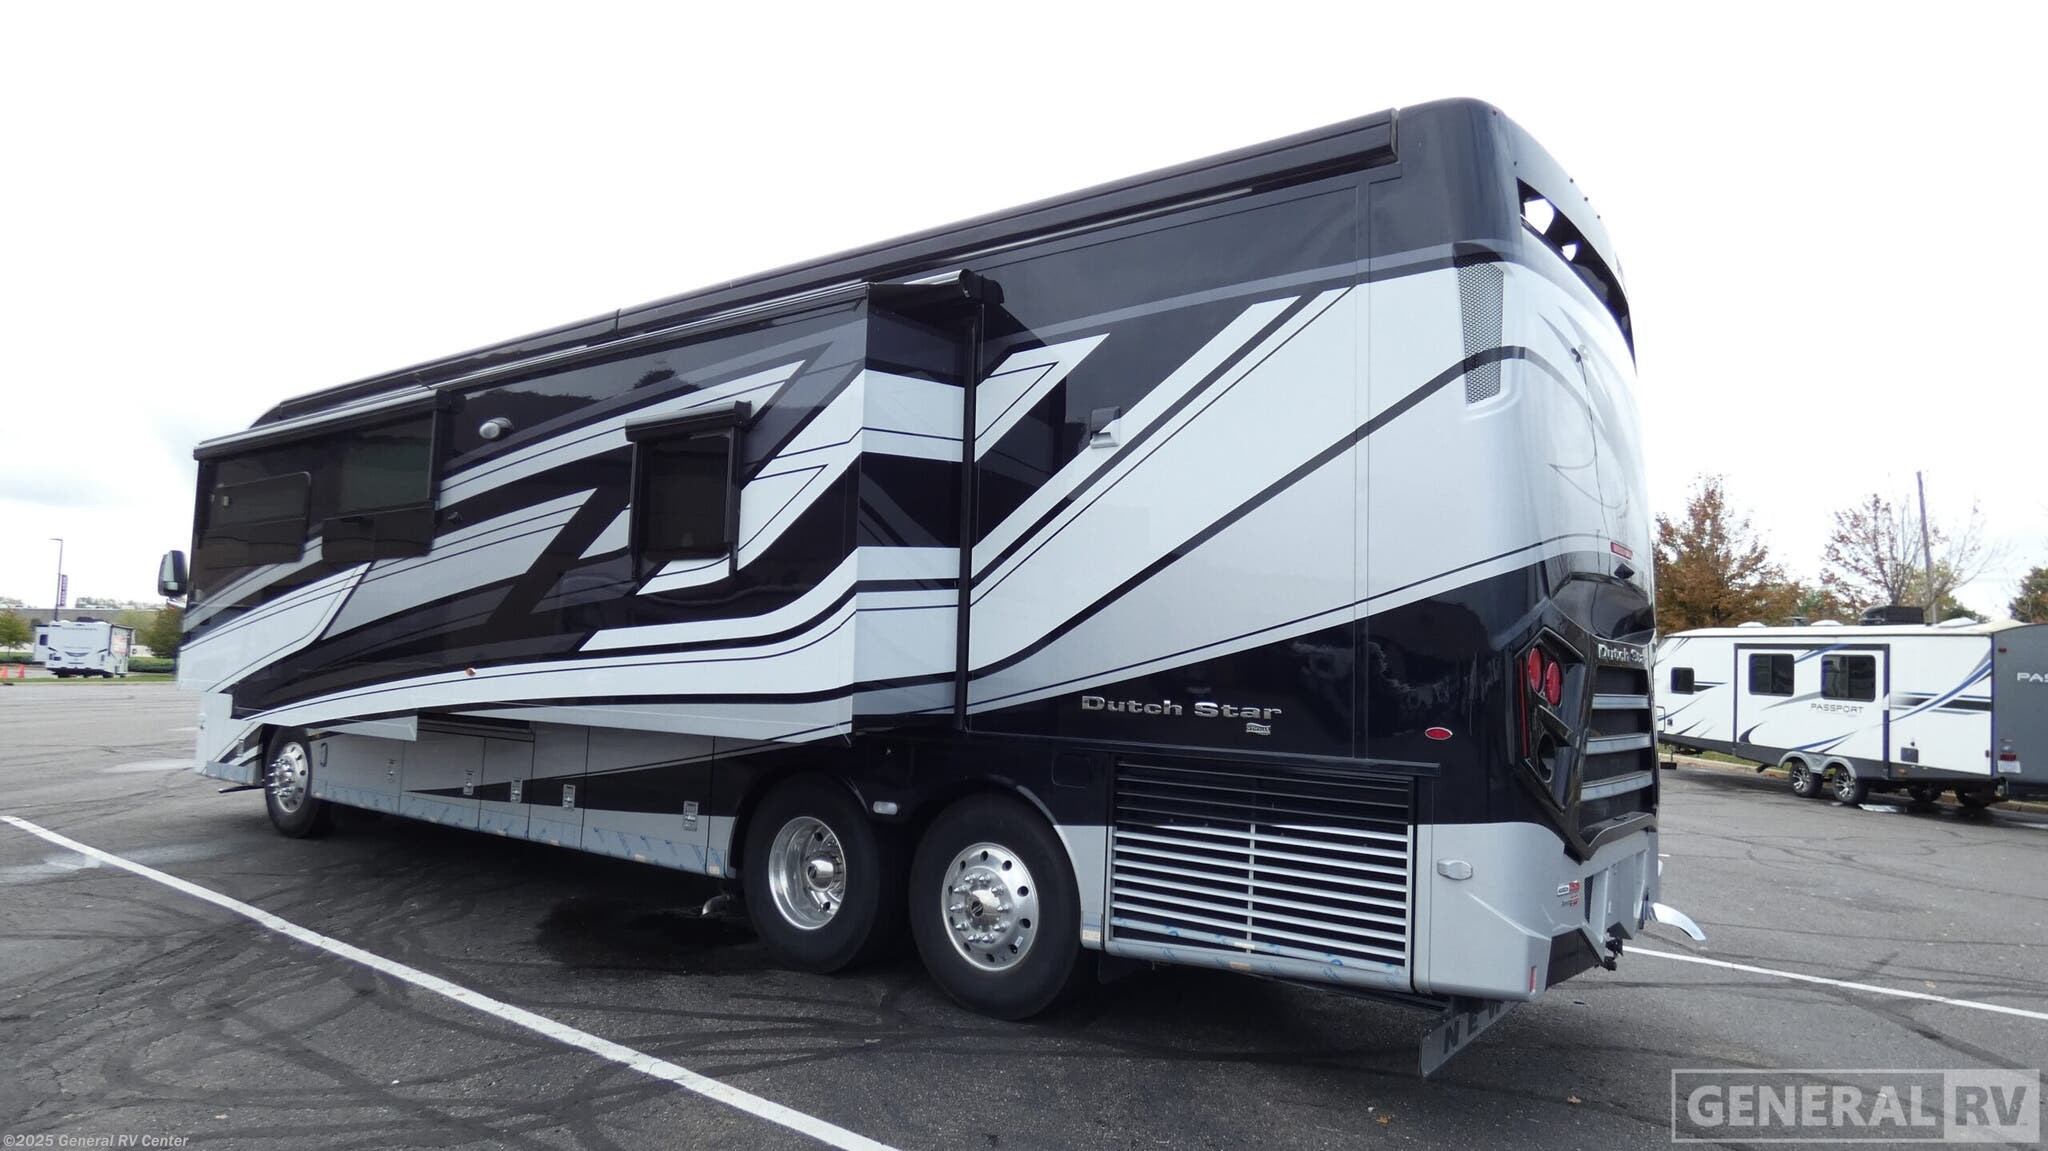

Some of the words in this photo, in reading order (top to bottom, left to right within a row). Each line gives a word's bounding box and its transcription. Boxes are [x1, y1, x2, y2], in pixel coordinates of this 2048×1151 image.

[1081, 695, 1183, 716] Dutch
[1194, 701, 1283, 720] Star
[1810, 703, 1865, 714] PASSPORT
